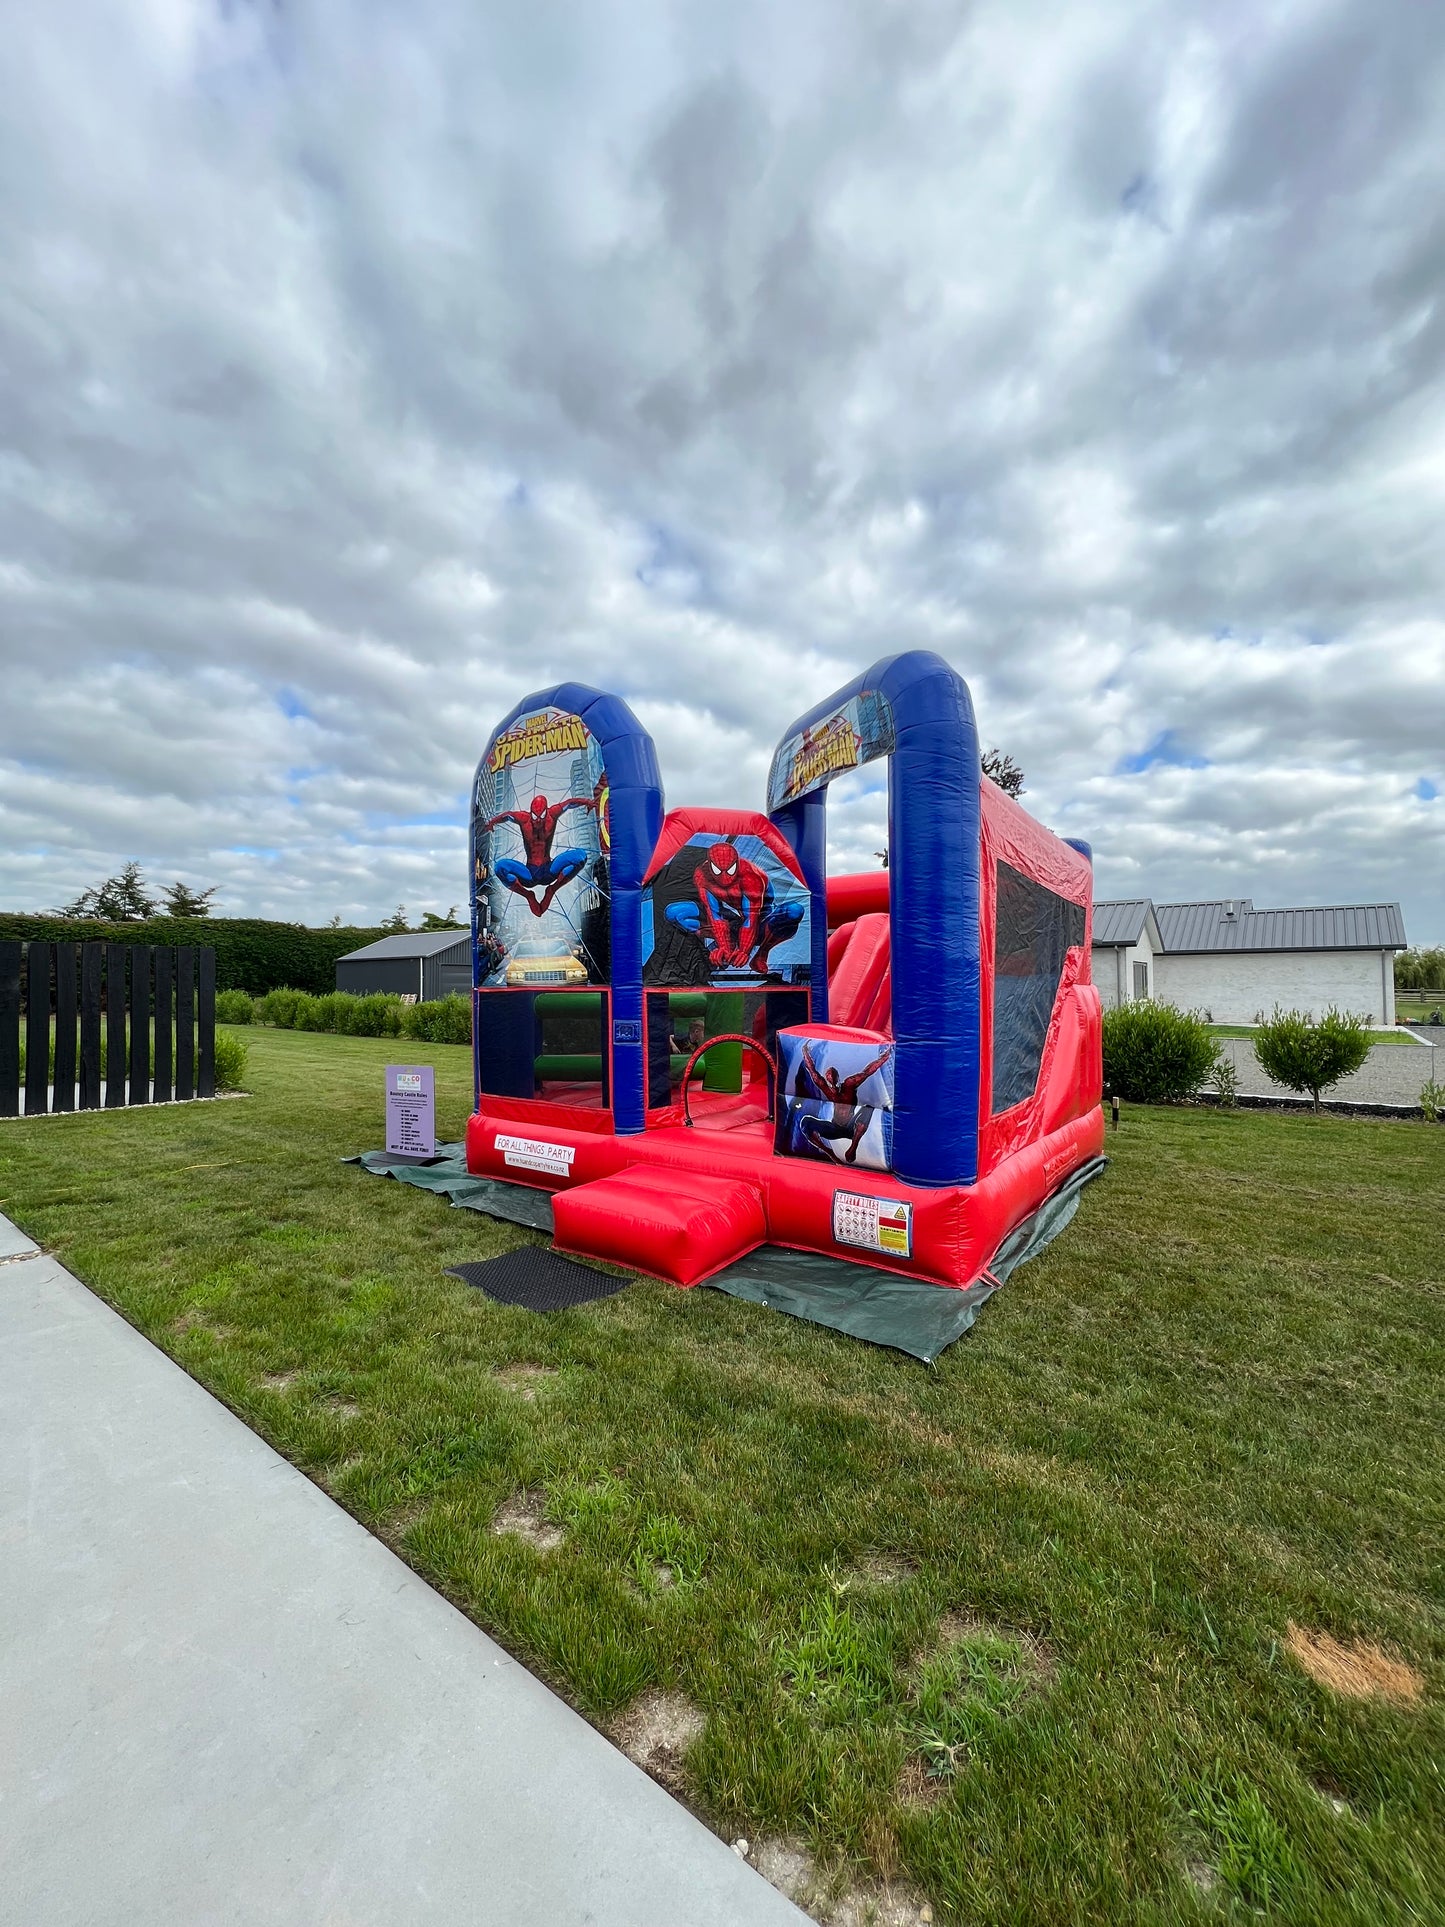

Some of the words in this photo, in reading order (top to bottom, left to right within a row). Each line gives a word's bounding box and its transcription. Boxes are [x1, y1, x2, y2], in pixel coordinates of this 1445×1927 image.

[497, 716, 581, 745] ULTIMATE
[526, 714, 548, 729] MARVEL
[490, 722, 588, 774] SPIDER-MAN
[497, 1138, 510, 1149] FOR
[510, 1141, 522, 1151] ALL
[523, 1142, 545, 1155] THINGS
[547, 1147, 573, 1161] PARTY
[836, 1193, 860, 1207] SAFETY
[859, 1198, 879, 1210] RULES
